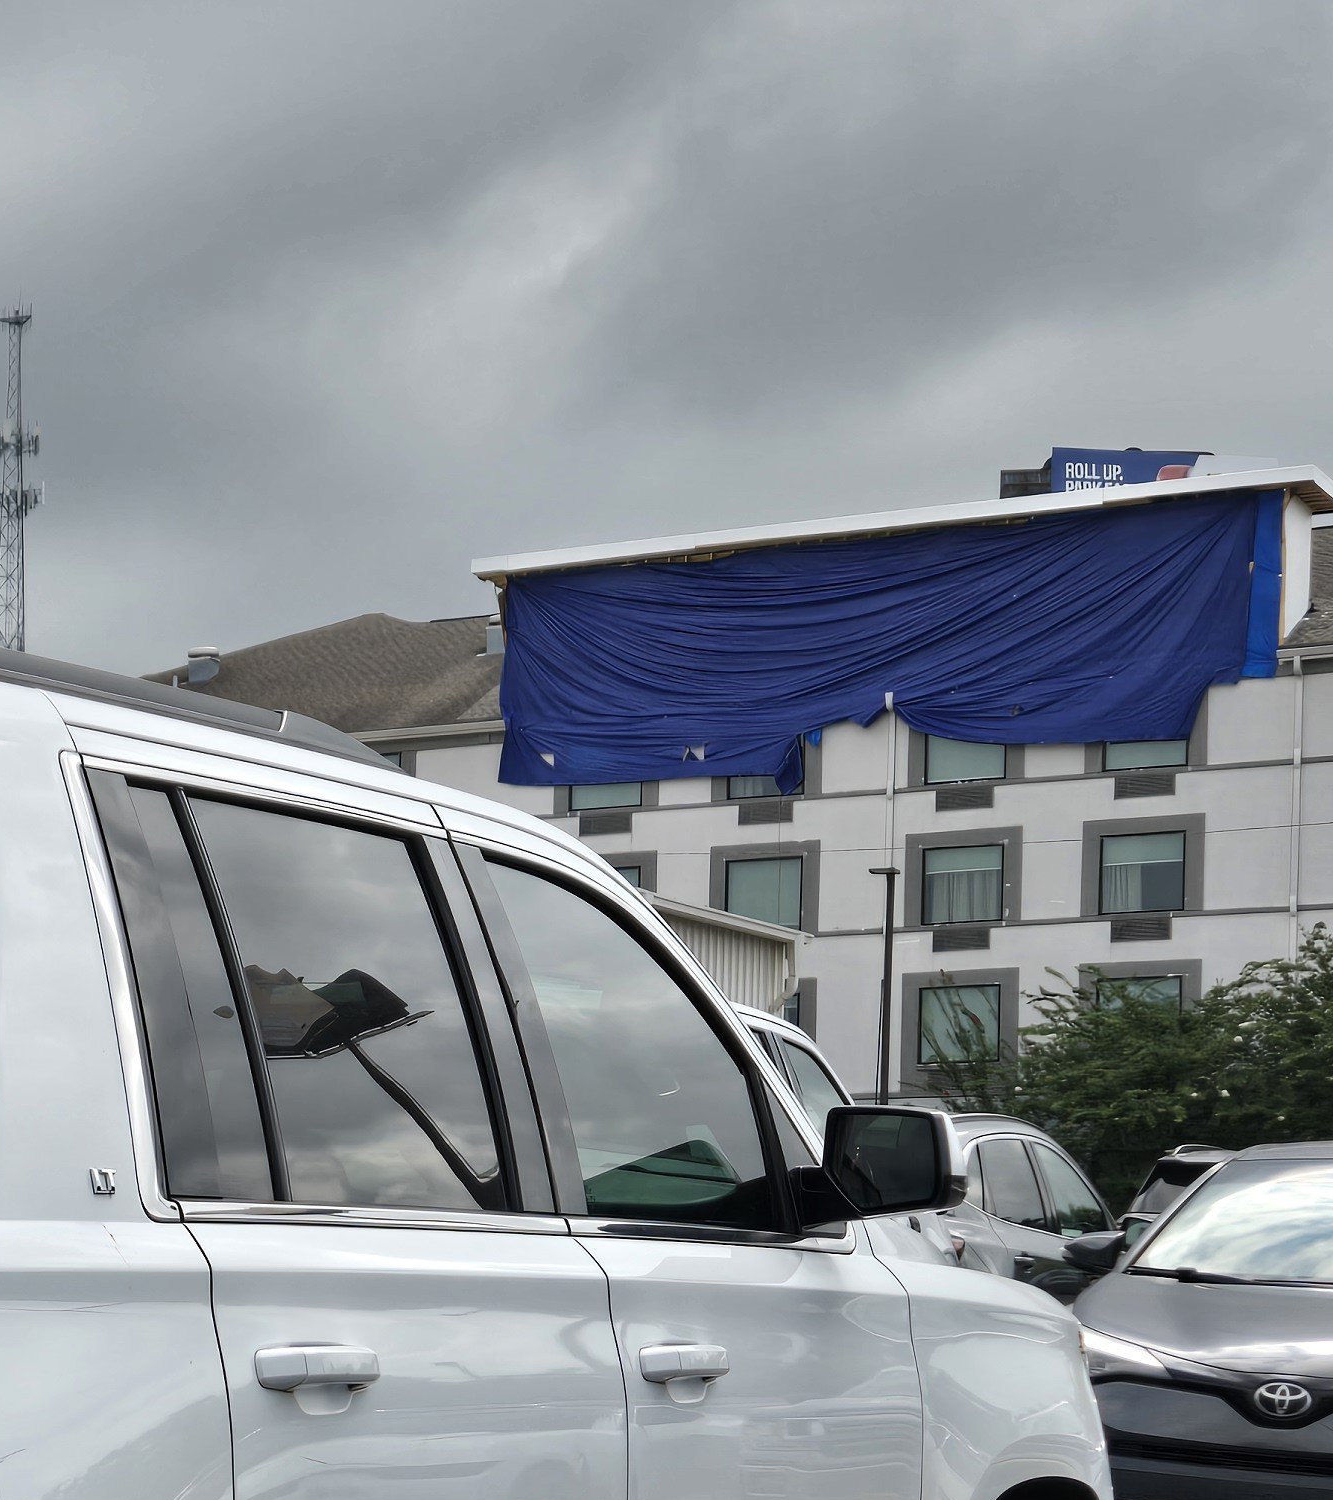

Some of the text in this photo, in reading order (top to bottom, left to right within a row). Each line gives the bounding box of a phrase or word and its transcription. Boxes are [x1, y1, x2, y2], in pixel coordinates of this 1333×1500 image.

[1065, 462, 1124, 481] ROLL UP.
[89, 1168, 117, 1195] LT
